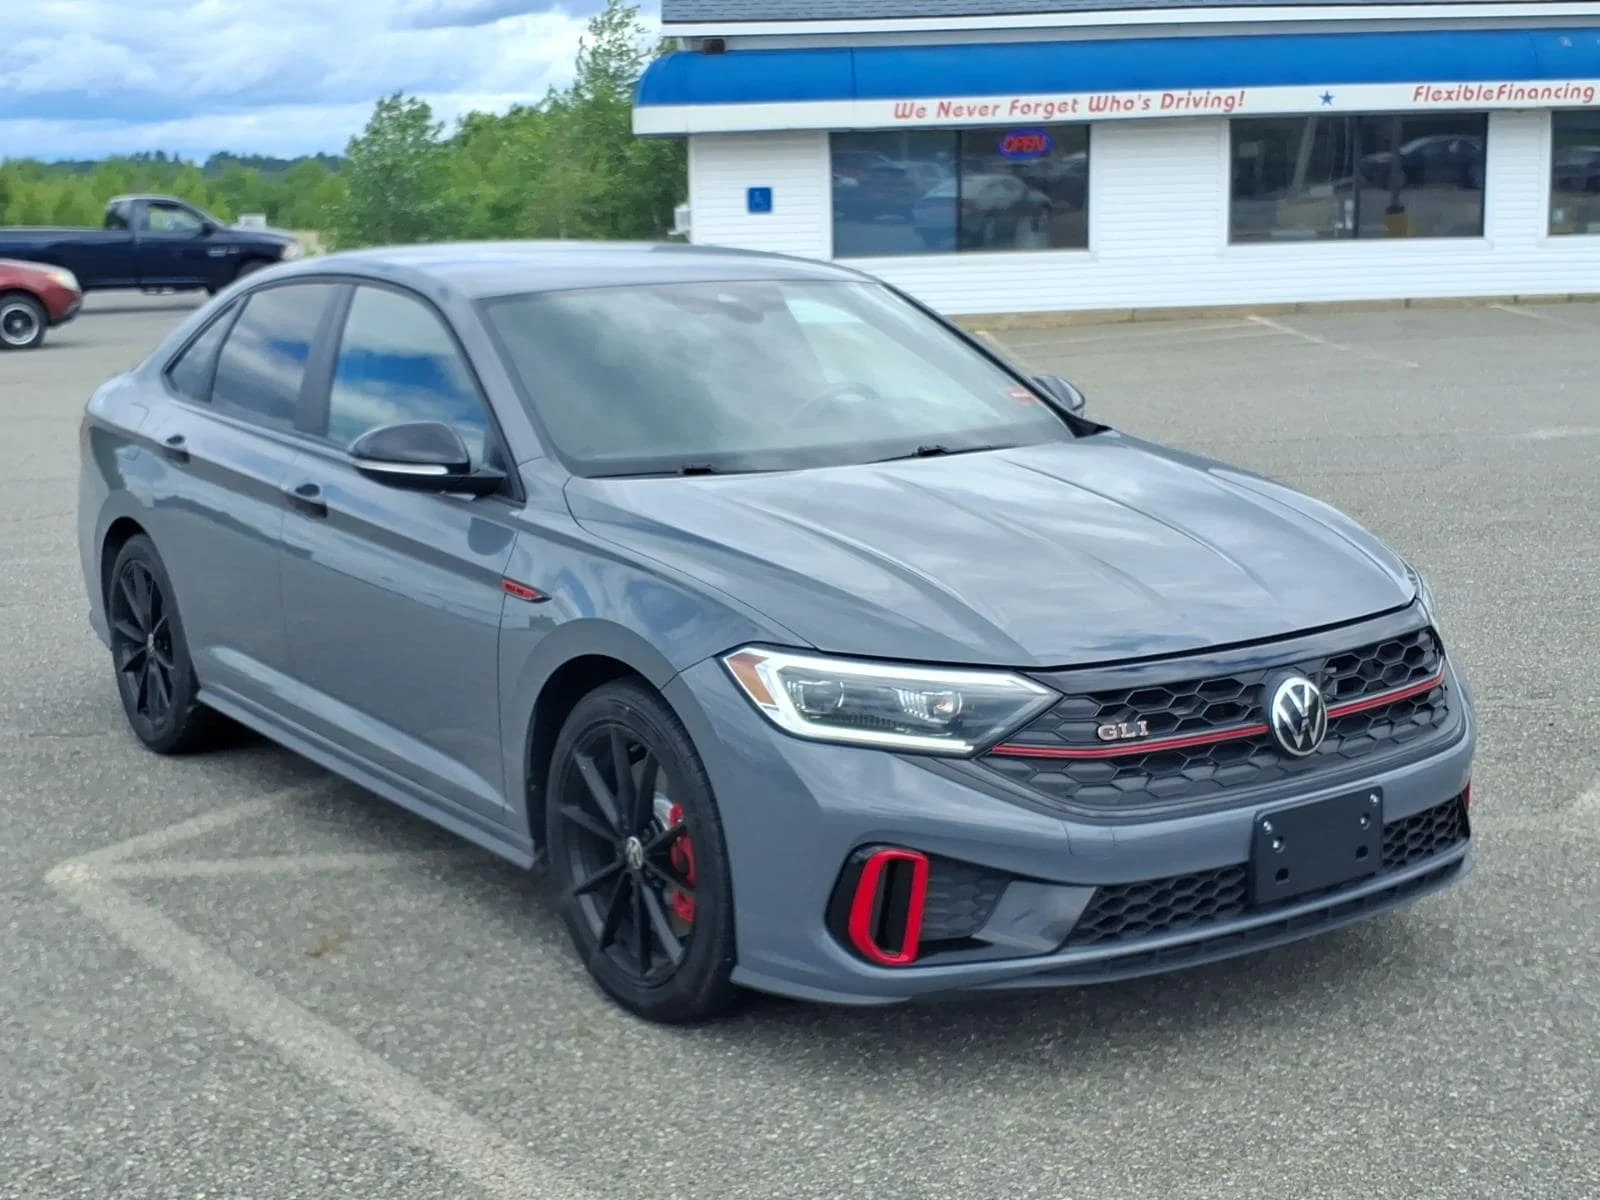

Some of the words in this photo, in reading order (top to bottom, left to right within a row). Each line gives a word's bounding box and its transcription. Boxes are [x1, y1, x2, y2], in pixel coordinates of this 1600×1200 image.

[893, 101, 928, 120] We
[936, 99, 1001, 119] Never
[1008, 97, 1080, 120] Forget
[1087, 93, 1152, 113] Who's
[1160, 89, 1246, 113] Driving!
[1003, 135, 1046, 153] OPEN
[1097, 720, 1149, 741] GLI
